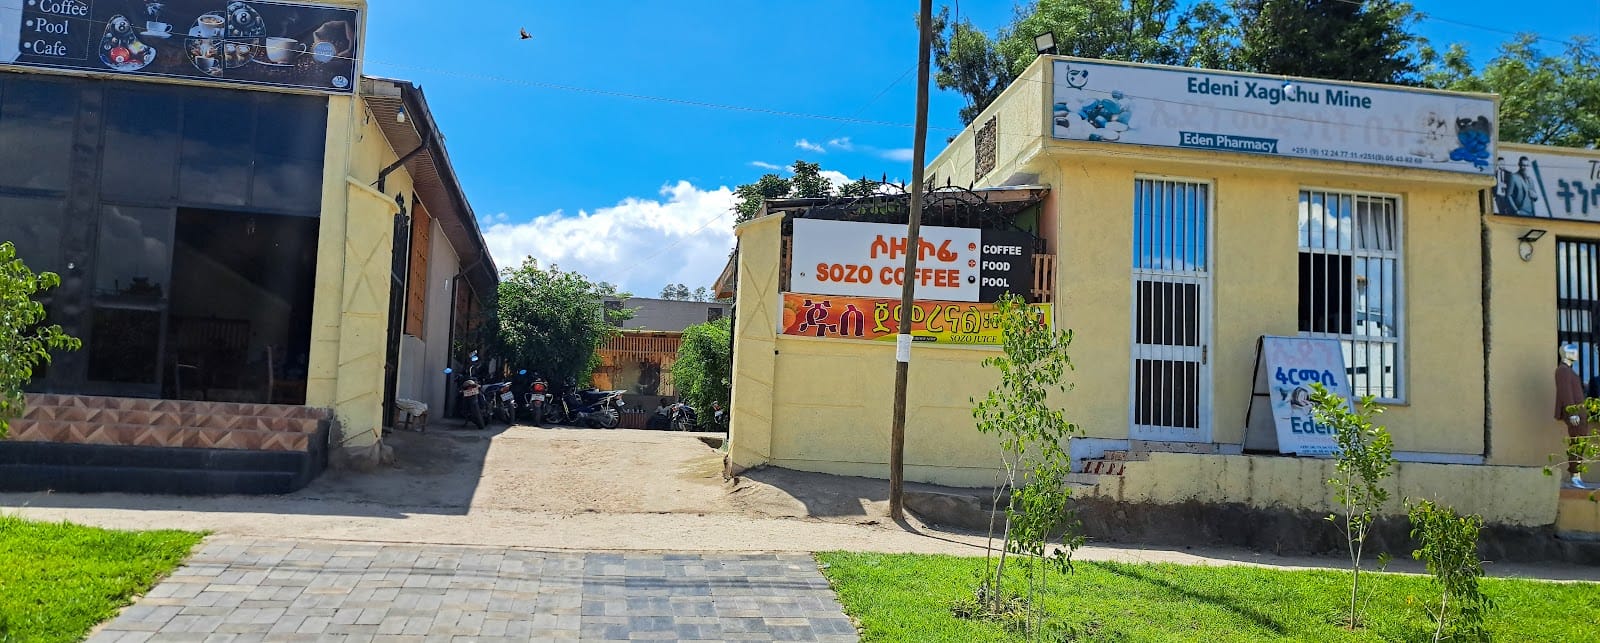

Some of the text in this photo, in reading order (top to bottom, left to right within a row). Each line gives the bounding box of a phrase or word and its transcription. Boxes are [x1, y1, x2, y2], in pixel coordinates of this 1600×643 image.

[40, 0, 88, 15] Coffee
[35, 17, 69, 35] Pool
[33, 39, 67, 56] Cafe
[1187, 76, 1239, 97] Edeni
[1325, 89, 1372, 109] Mine
[1183, 132, 1275, 153] Eden Pharmacy
[1340, 150, 1349, 158] 77
[982, 244, 1022, 256] COFFEE
[816, 263, 873, 284] SOZO
[982, 260, 1011, 271] FOOD
[981, 277, 1010, 287] POOL
[973, 335, 998, 344] JUICE
[1275, 366, 1338, 387] ፋርማሲ
[1290, 416, 1338, 434] Eden
